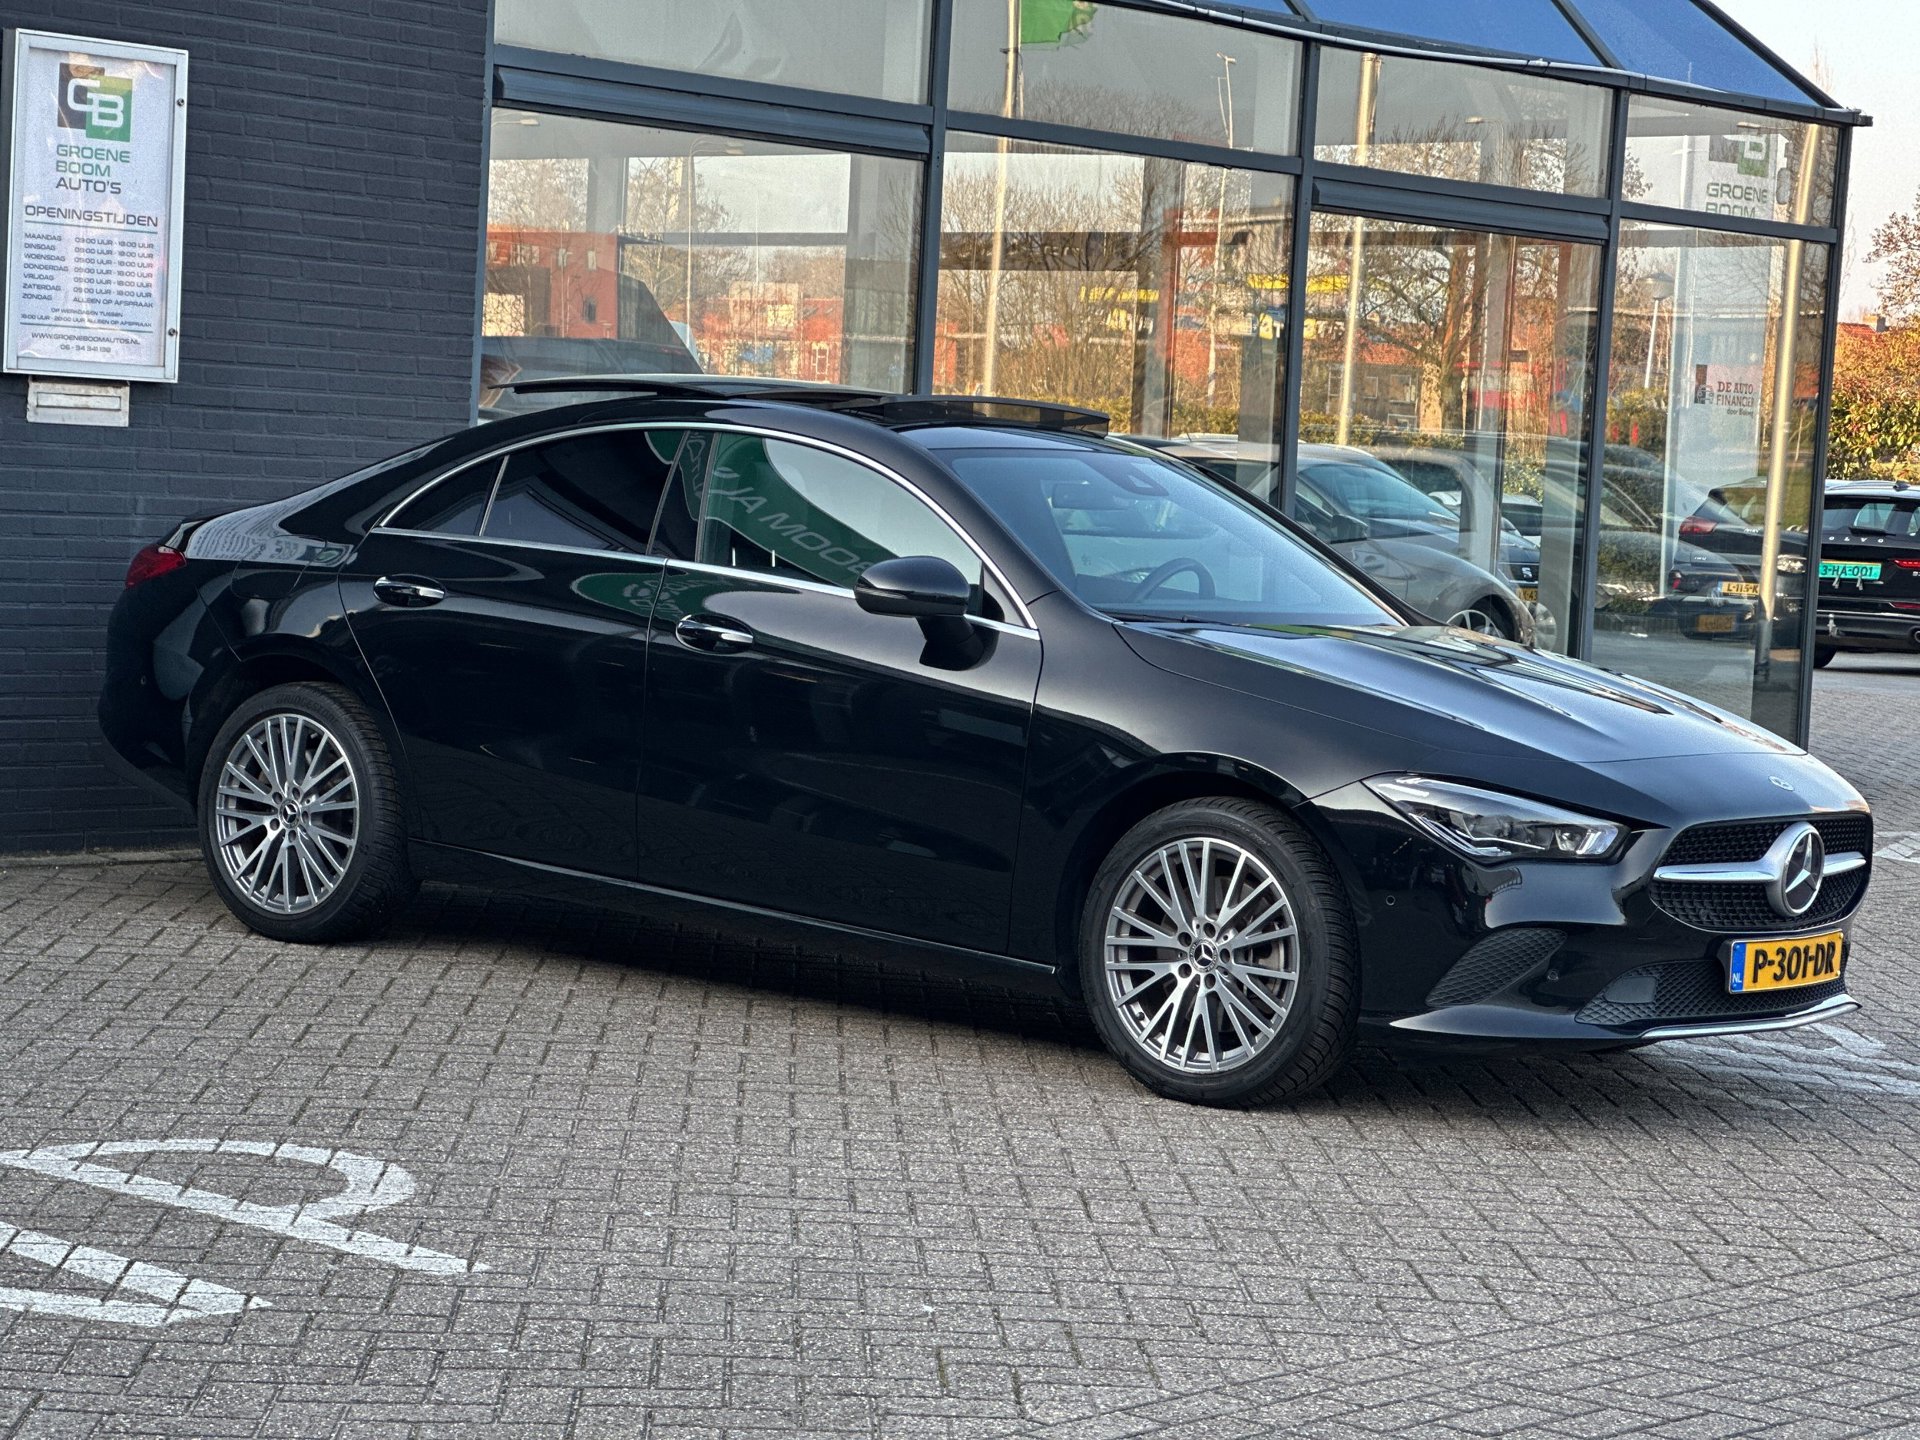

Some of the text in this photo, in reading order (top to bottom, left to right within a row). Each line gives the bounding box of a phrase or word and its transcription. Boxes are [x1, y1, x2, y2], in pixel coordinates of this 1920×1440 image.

[56, 144, 131, 163] GROENE
[55, 160, 111, 177] BOOM
[56, 177, 122, 195] AUTO'S
[1706, 182, 1769, 204] GROENE
[25, 205, 158, 227] OPENINGSTIJDEN
[1705, 202, 1757, 218] BOOM
[22, 283, 61, 291] ZATERDAG
[1717, 381, 1754, 395] DE AUTO
[1727, 583, 1759, 594] L-115-K
[1732, 941, 1836, 983] NL P-301-DR
